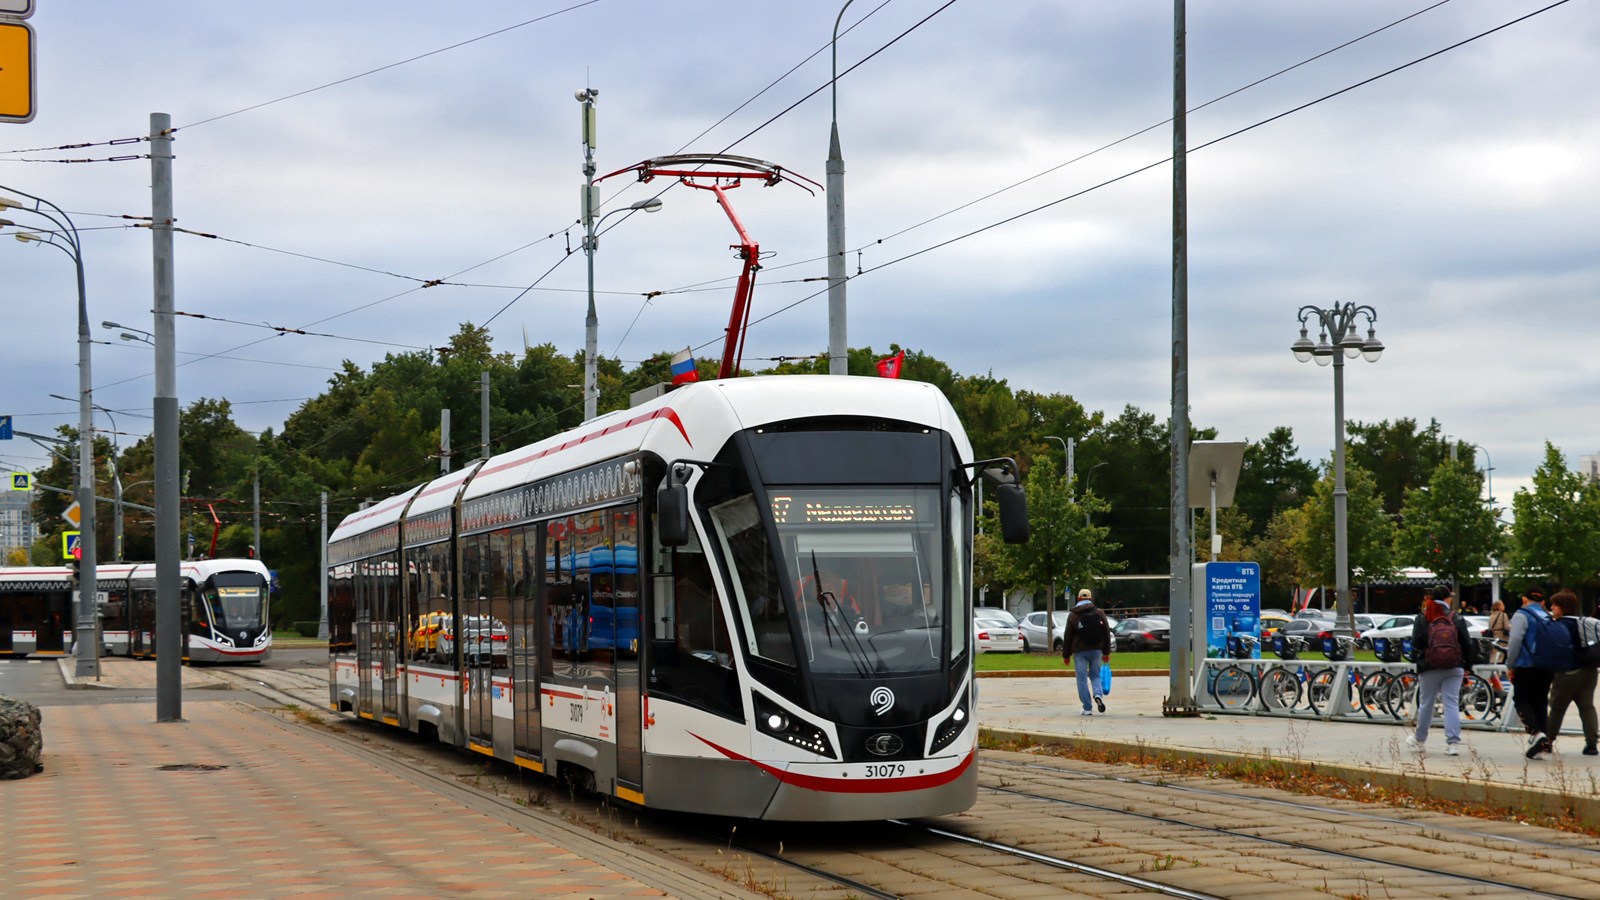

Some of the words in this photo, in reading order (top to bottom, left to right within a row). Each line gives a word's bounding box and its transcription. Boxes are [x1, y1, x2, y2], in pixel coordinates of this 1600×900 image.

[771, 497, 792, 522] 7
[806, 503, 914, 521] Медведково
[865, 764, 905, 778] 31079
